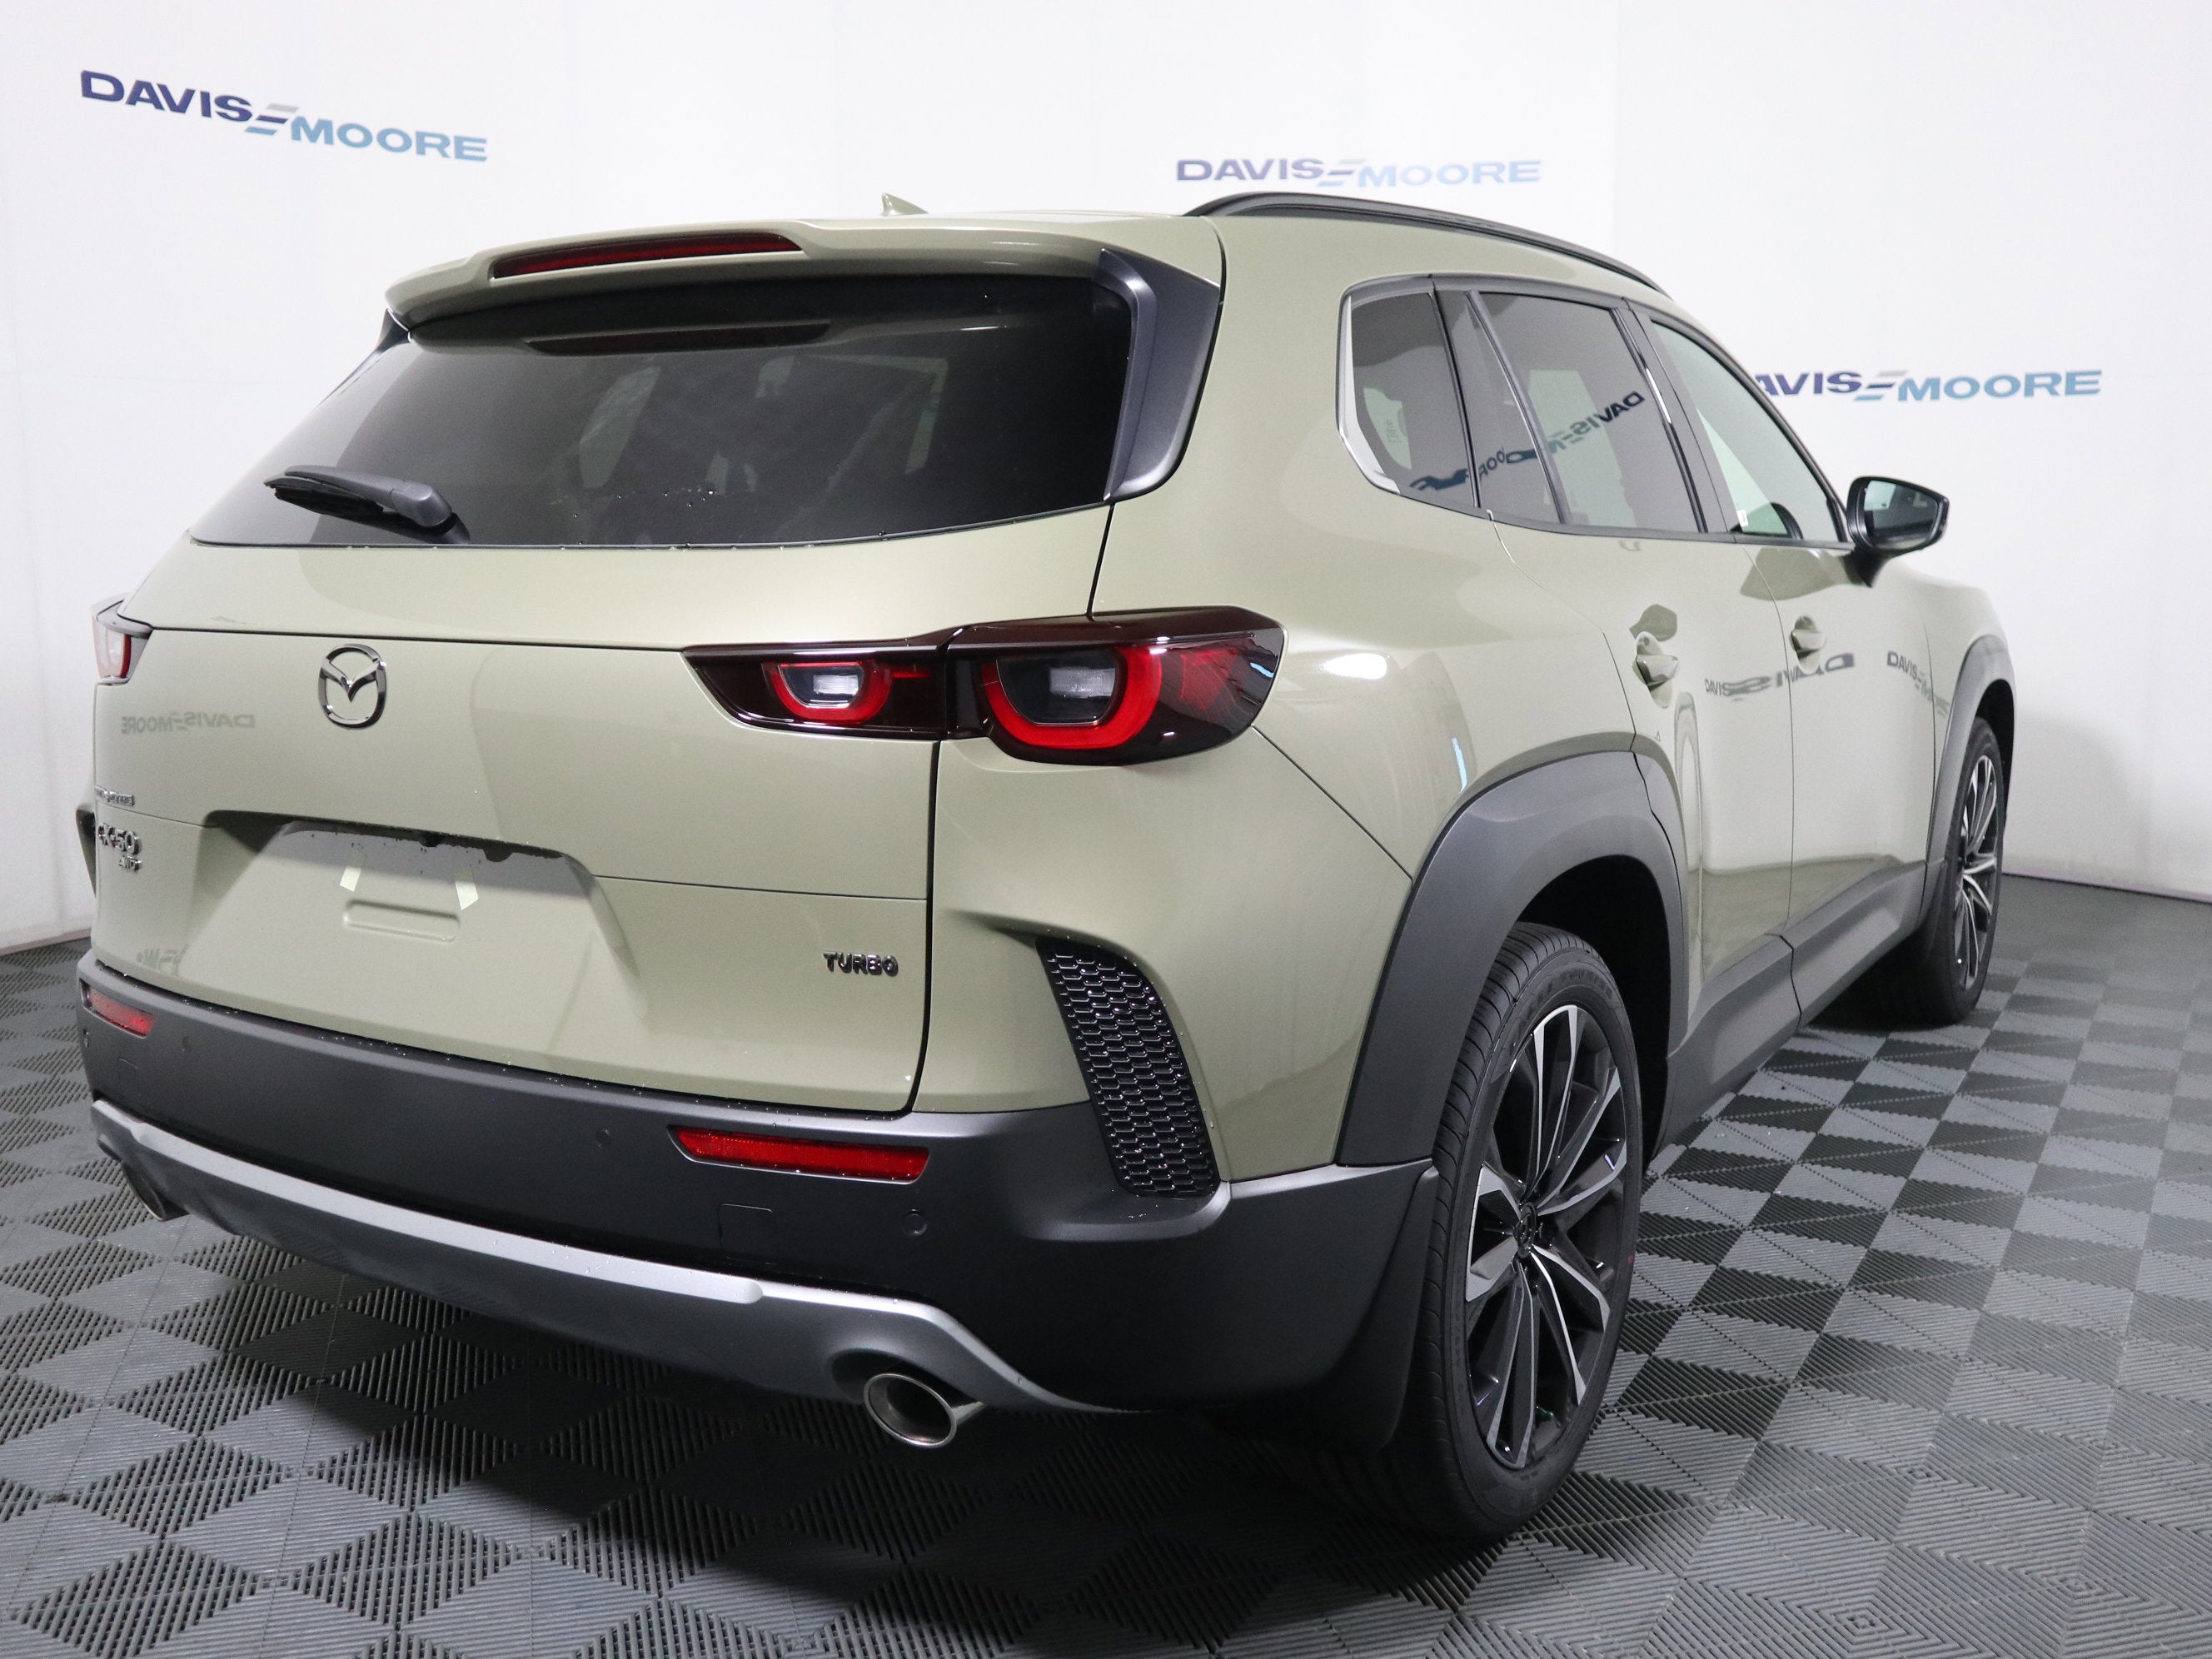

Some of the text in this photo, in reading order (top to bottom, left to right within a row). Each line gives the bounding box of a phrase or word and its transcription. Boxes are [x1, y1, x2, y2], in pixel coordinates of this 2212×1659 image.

[81, 70, 487, 162] DAVIS MOORE
[1177, 157, 1542, 188] DAVIS MOORE
[1753, 370, 2102, 401] AVIS MOORE
[823, 951, 899, 977] TURBO
